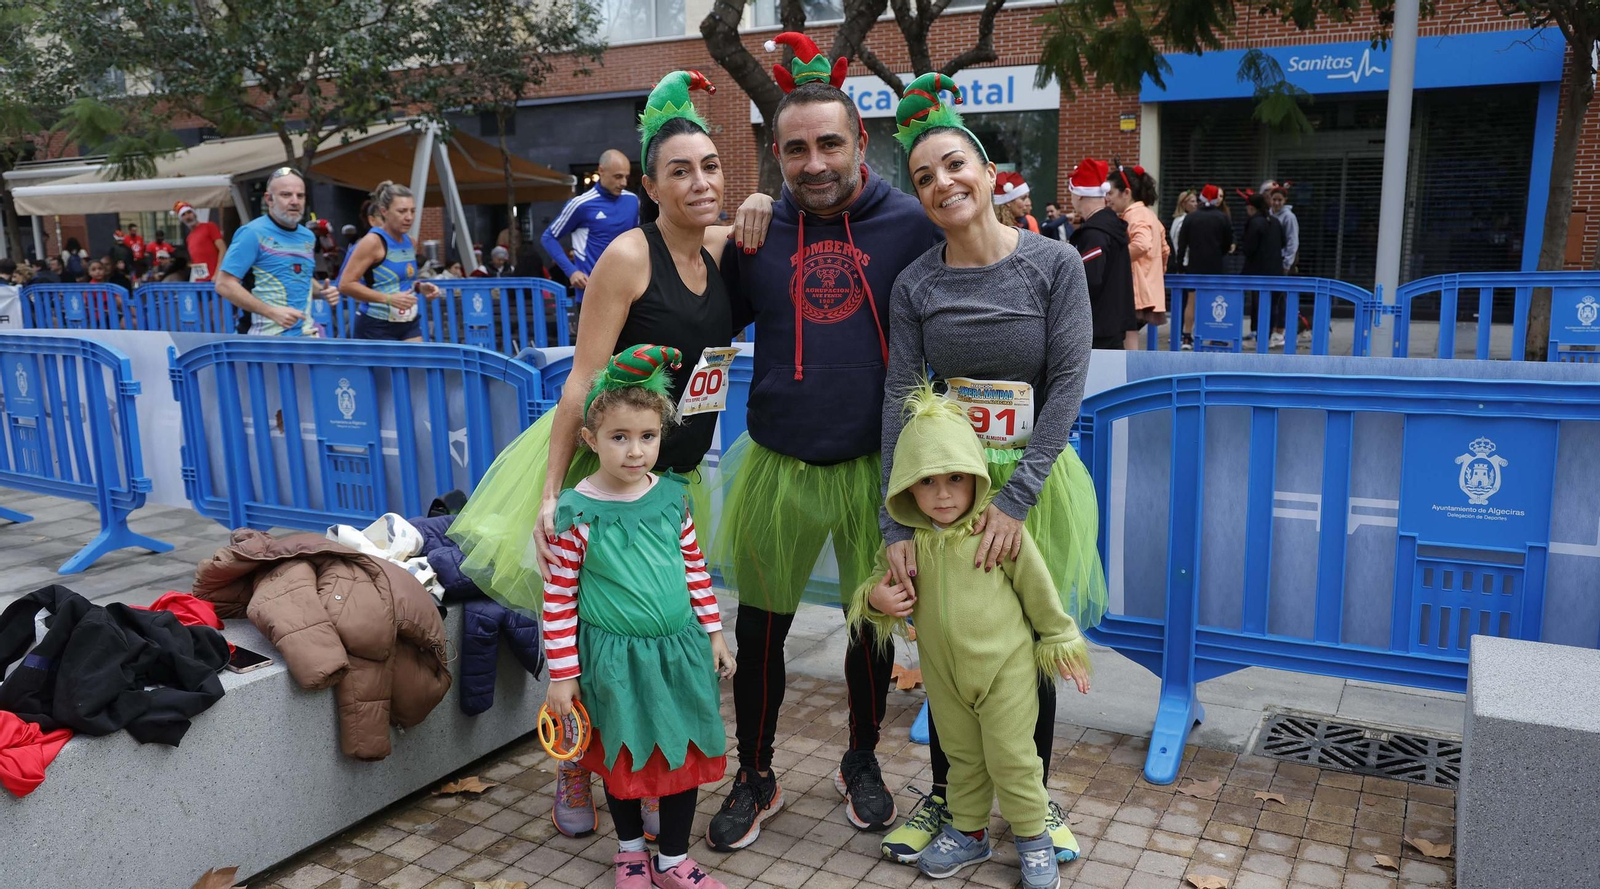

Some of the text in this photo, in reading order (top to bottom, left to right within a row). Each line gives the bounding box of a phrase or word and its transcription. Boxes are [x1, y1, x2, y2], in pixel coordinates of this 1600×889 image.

[1287, 55, 1354, 72] Sanitas
[939, 75, 1015, 106] ntal
[790, 240, 871, 267] BOMBEROS
[690, 369, 722, 397] 00
[967, 406, 1015, 436] 91
[1431, 504, 1477, 513] Ayuntamiento
[1487, 507, 1525, 516] Algeciras
